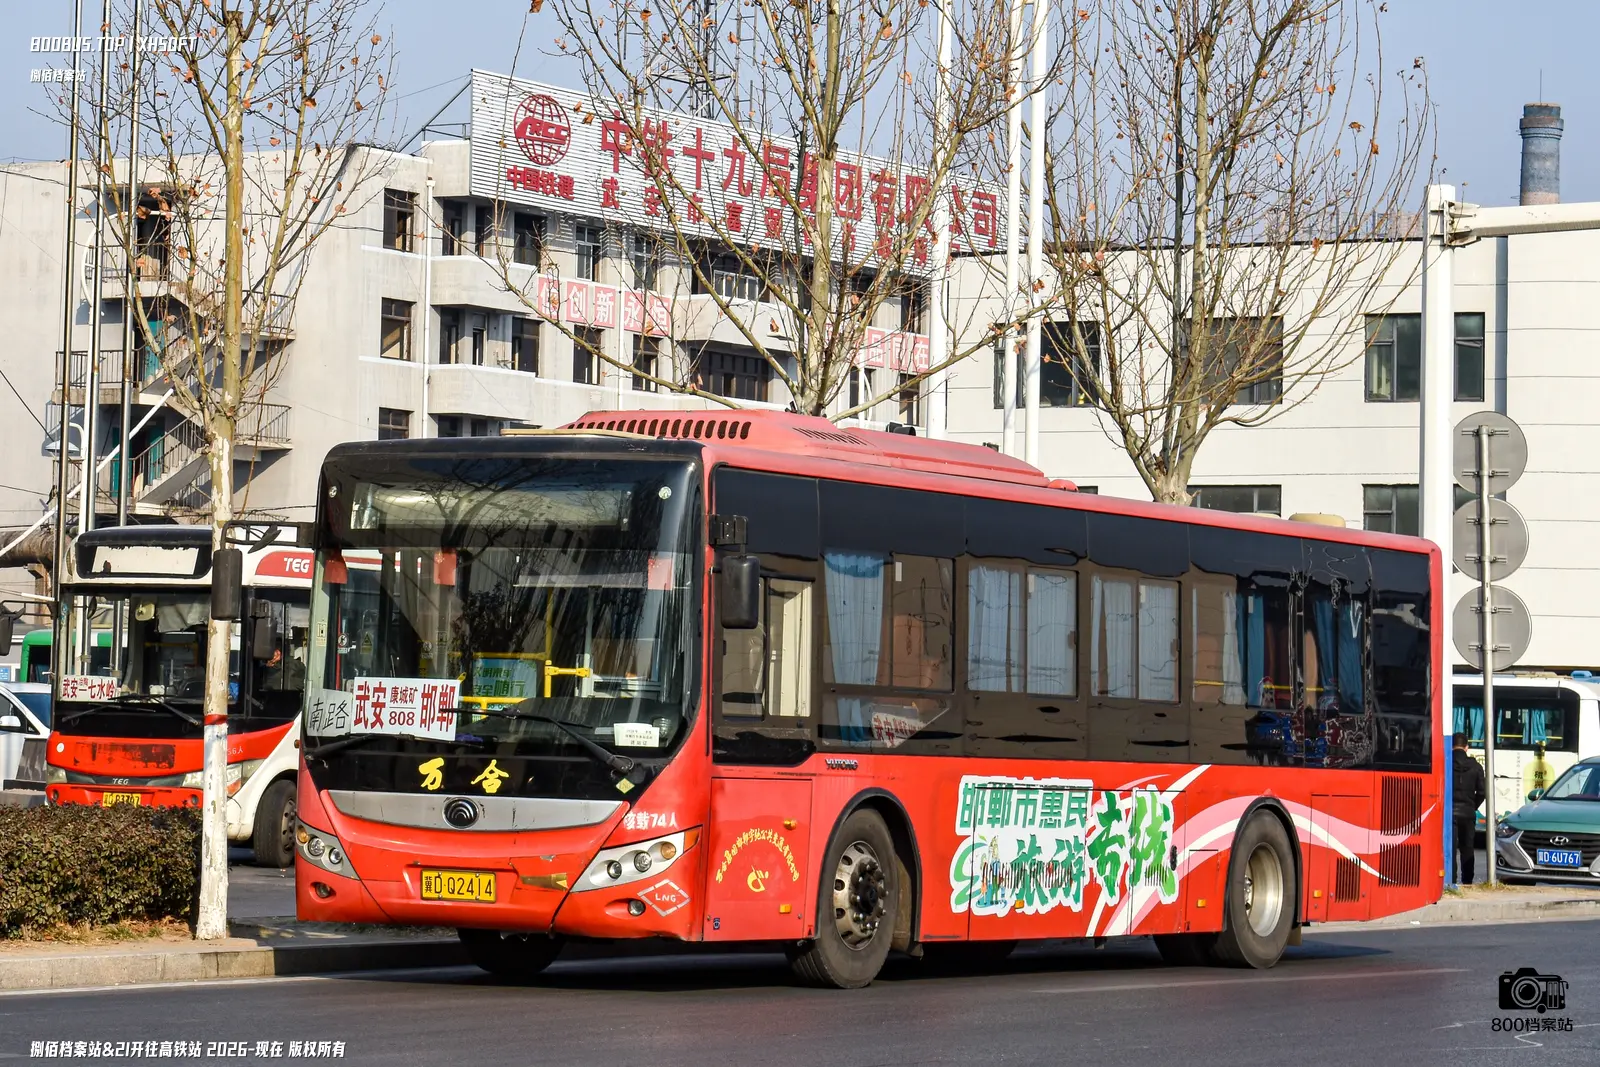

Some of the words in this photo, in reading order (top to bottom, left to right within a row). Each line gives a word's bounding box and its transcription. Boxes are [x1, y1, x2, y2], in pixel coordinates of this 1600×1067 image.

[506, 164, 575, 201] 中国铁建
[283, 557, 310, 573] TEG
[390, 685, 418, 704] 康城矿
[309, 697, 350, 732] 南路
[354, 681, 387, 729] 武安
[420, 683, 457, 732] 邯郸
[388, 711, 415, 726] 808
[825, 758, 858, 771] YUTONG
[959, 783, 1089, 829] 邯郸市惠民
[623, 810, 680, 831] 核载74人
[655, 893, 677, 902] LNG
